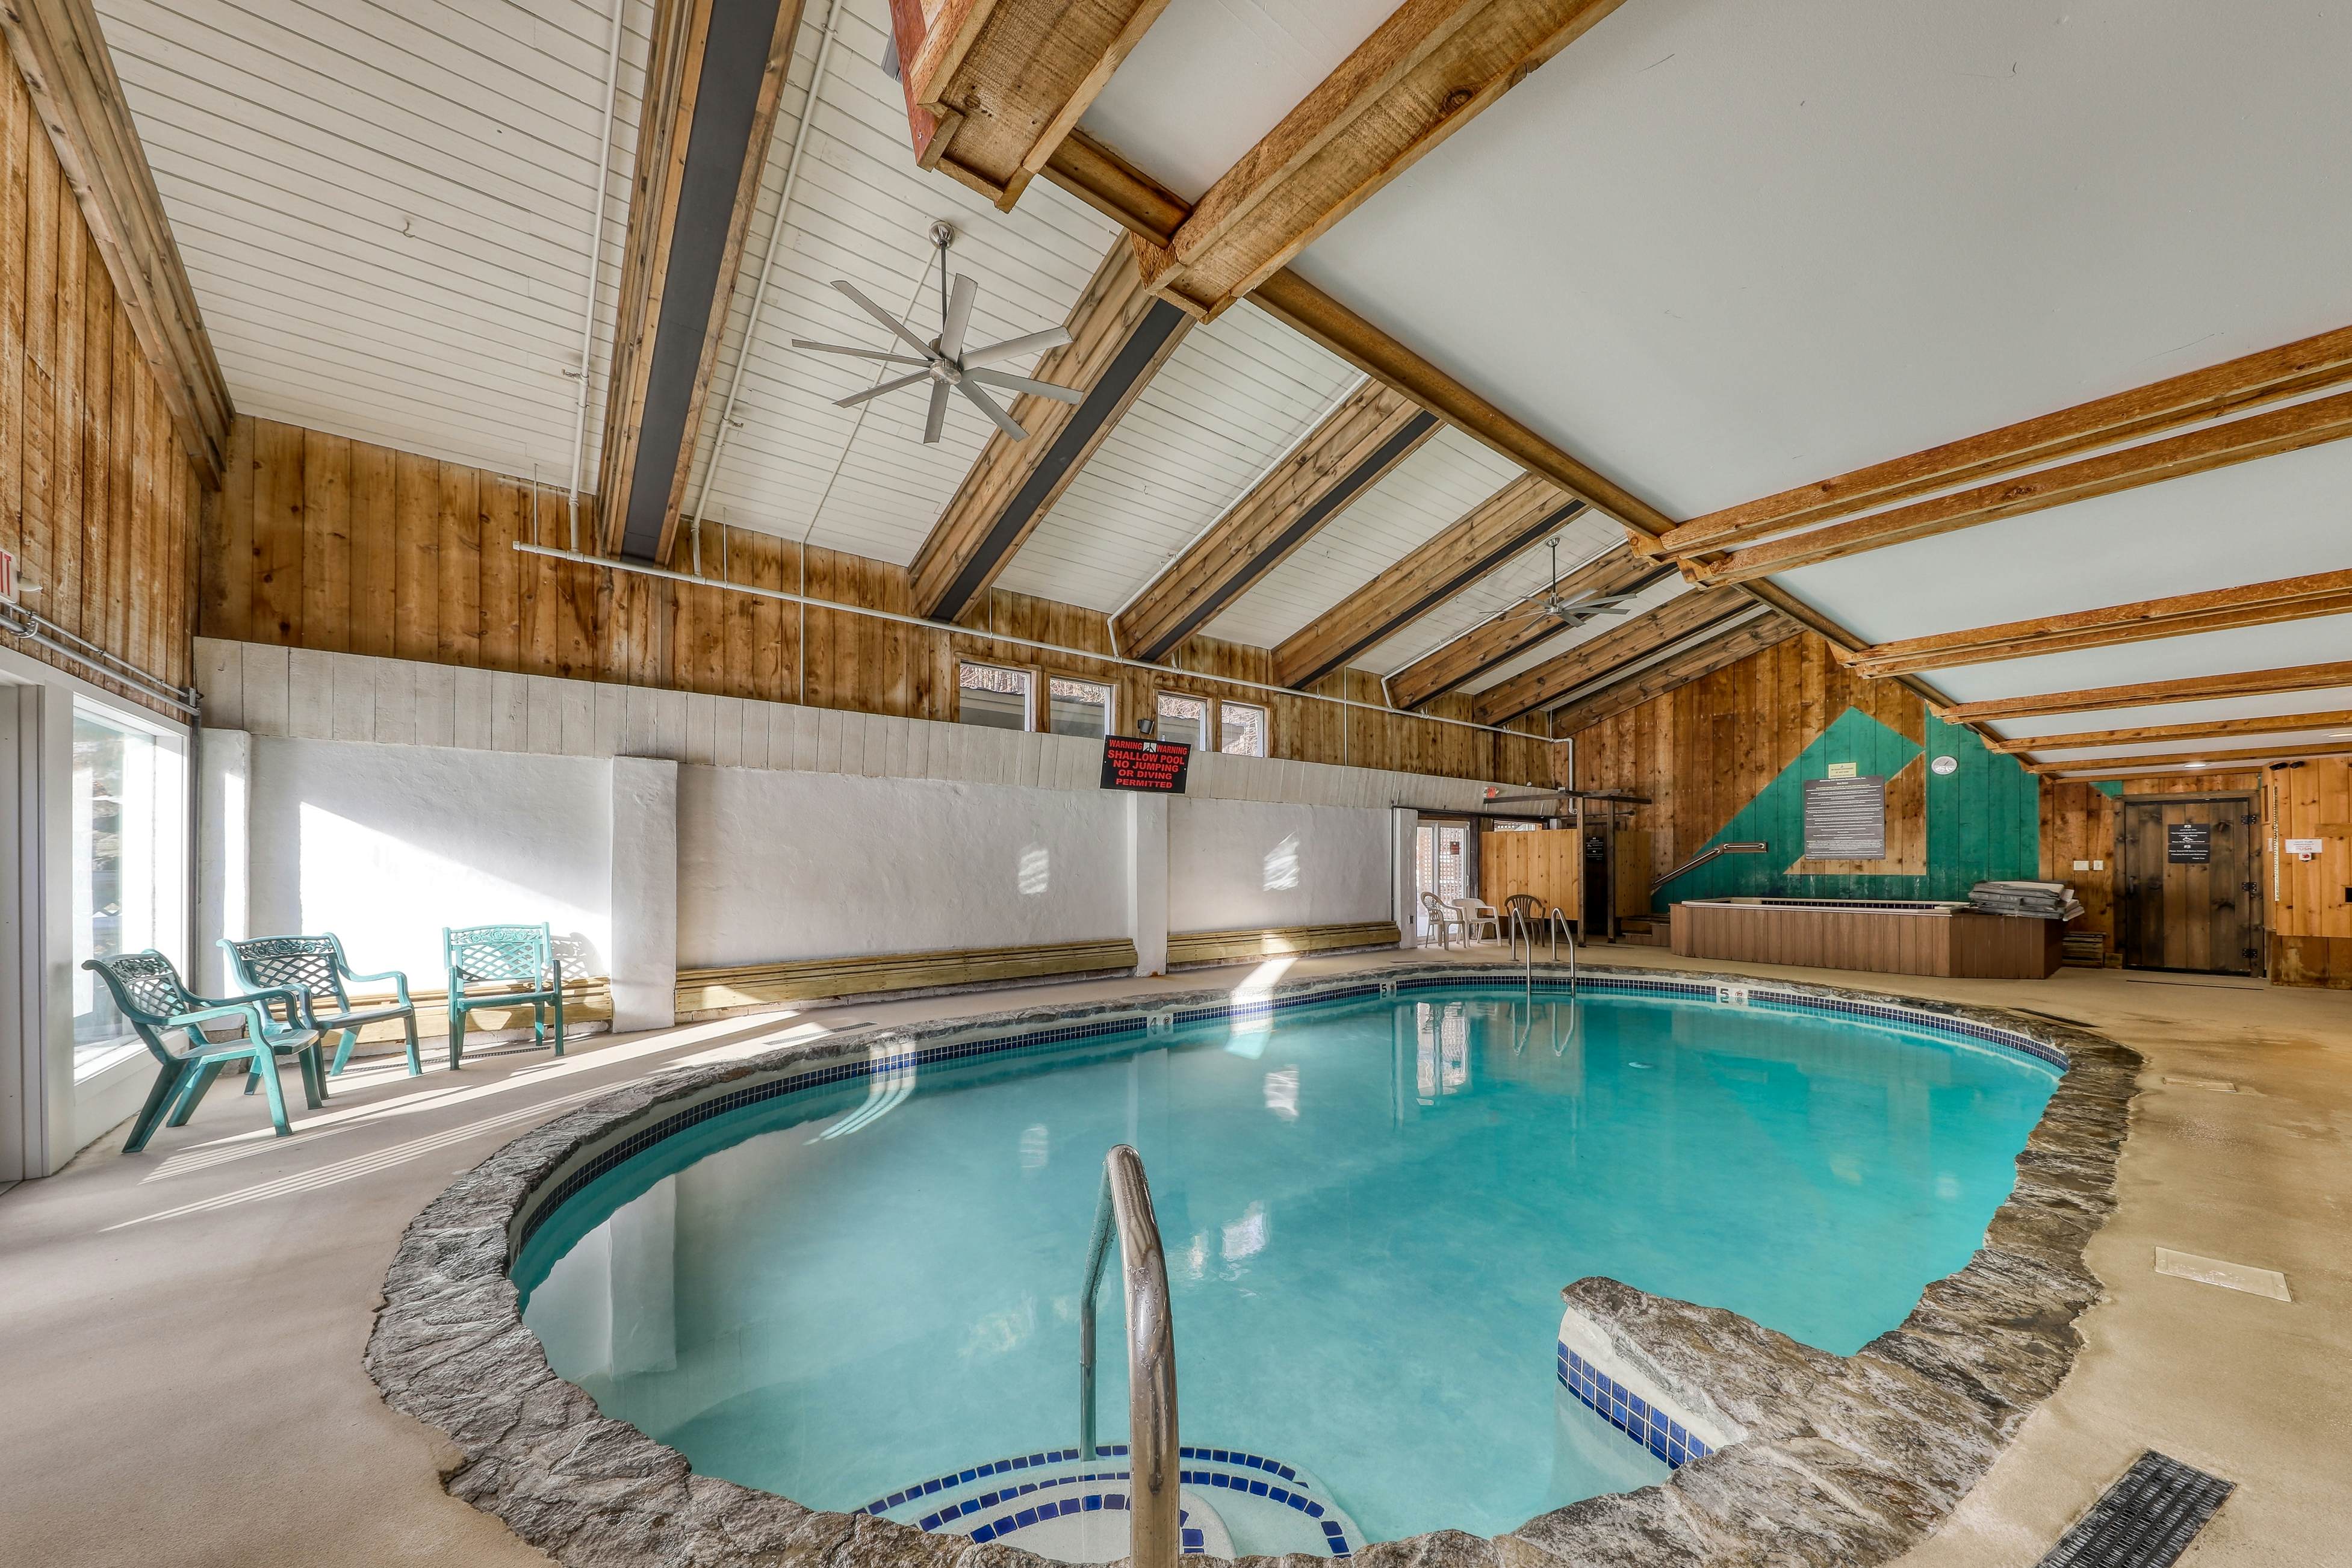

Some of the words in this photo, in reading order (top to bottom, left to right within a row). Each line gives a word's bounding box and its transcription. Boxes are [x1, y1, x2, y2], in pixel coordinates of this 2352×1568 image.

[0, 551, 11, 597] IT
[1109, 739, 1143, 750] WARNING
[1156, 745, 1187, 755] WARNING
[1108, 749, 1158, 763] SHALLOW
[1160, 755, 1185, 765] POOL
[1113, 760, 1129, 768] NO
[1132, 762, 1179, 772] JUMPING
[1115, 778, 1173, 789] PERMITTED
[1382, 984, 1387, 993] 5
[1150, 1017, 1157, 1026] 4
